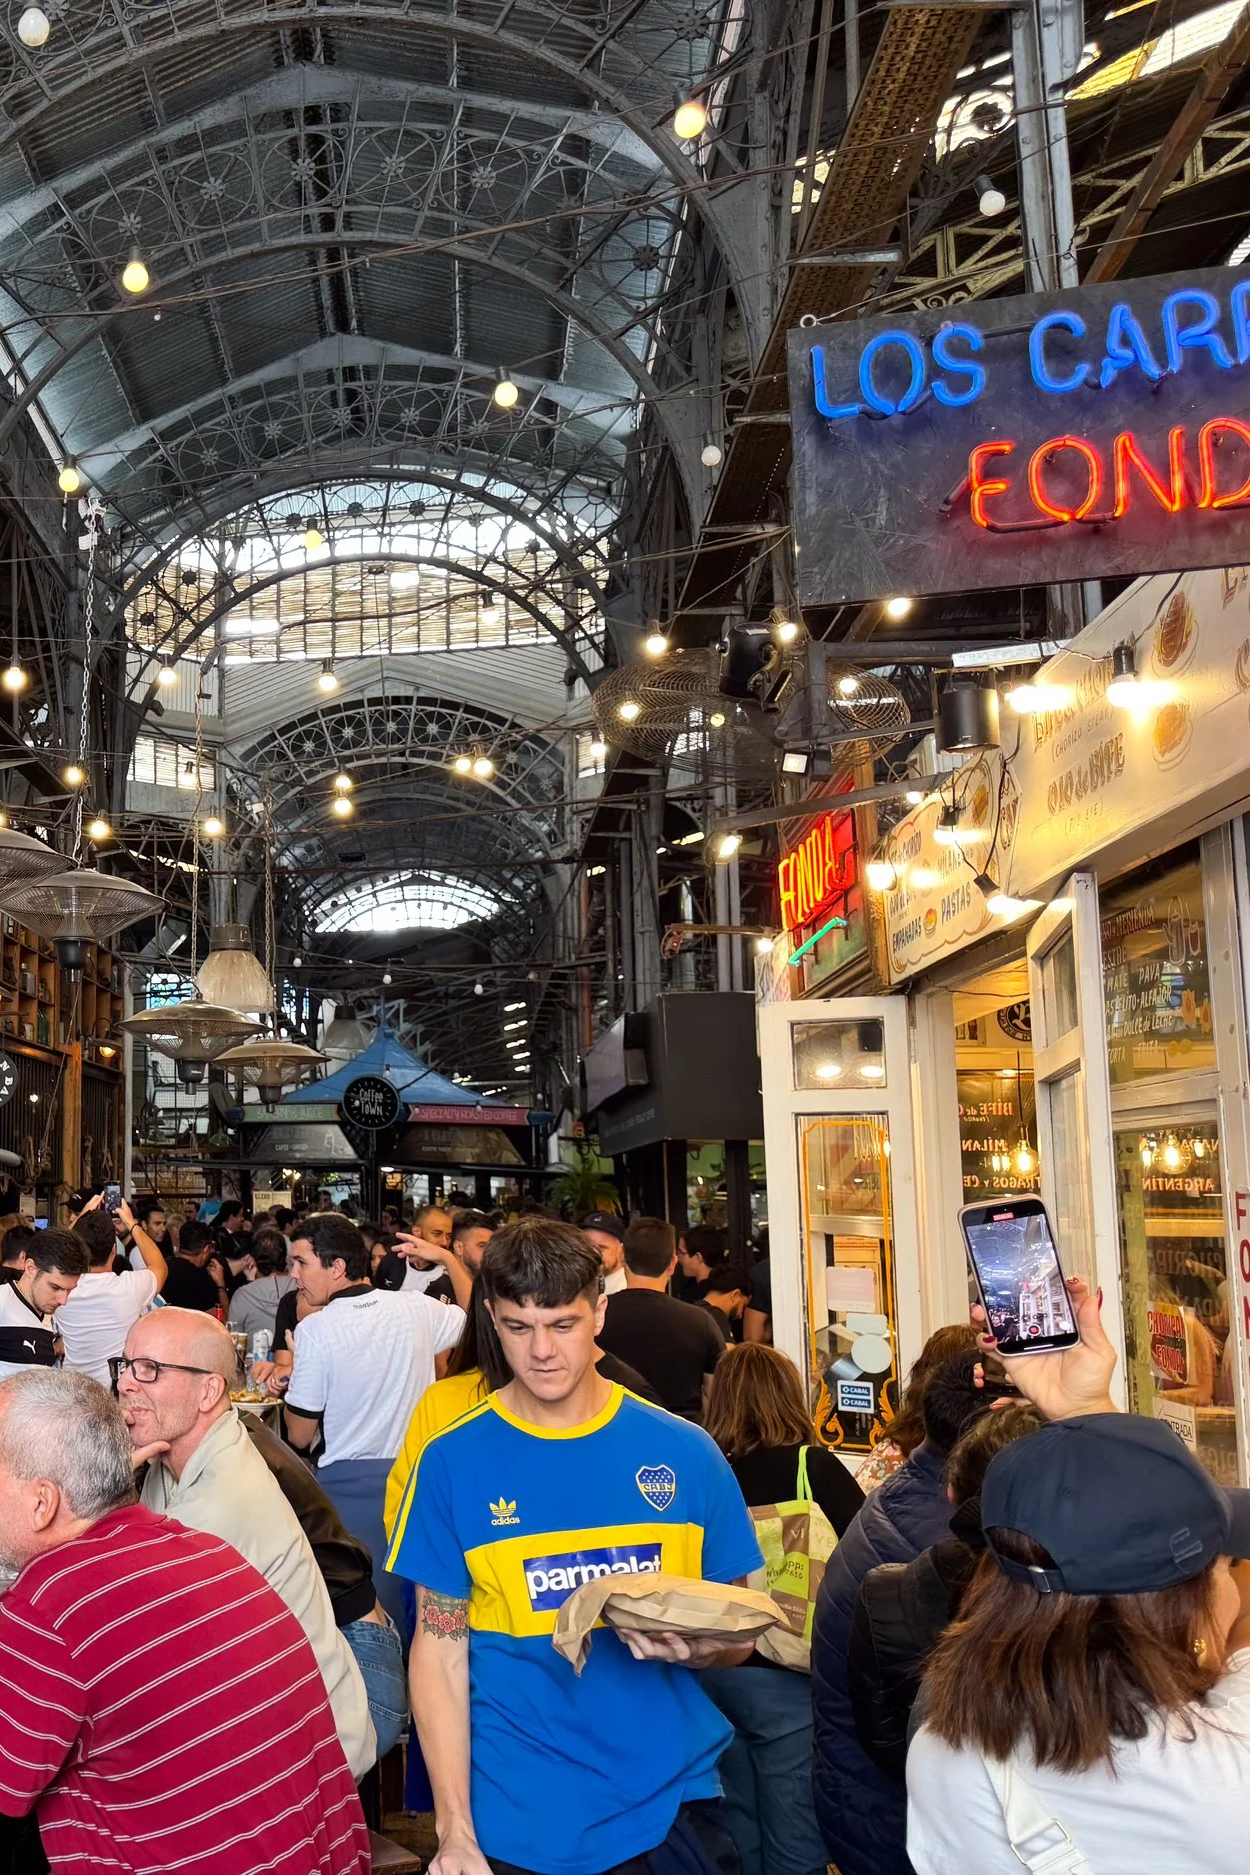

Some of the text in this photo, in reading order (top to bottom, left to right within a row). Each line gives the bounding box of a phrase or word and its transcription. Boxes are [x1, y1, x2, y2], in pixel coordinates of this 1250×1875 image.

[811, 327, 986, 418] LOS
[969, 417, 1250, 528] FOND
[941, 881, 971, 924] PASTAS
[892, 917, 922, 954] EMPANADAS
[1139, 963, 1160, 985] PAVA
[1124, 1016, 1144, 1036] DULCE
[493, 1110, 518, 1122] COFFEE
[850, 1386, 869, 1395] CABAL
[850, 1398, 870, 1408] CABAL
[644, 1483, 673, 1491] CABJ
[491, 1516, 520, 1525] adidas
[526, 1554, 662, 1599] parmalat
